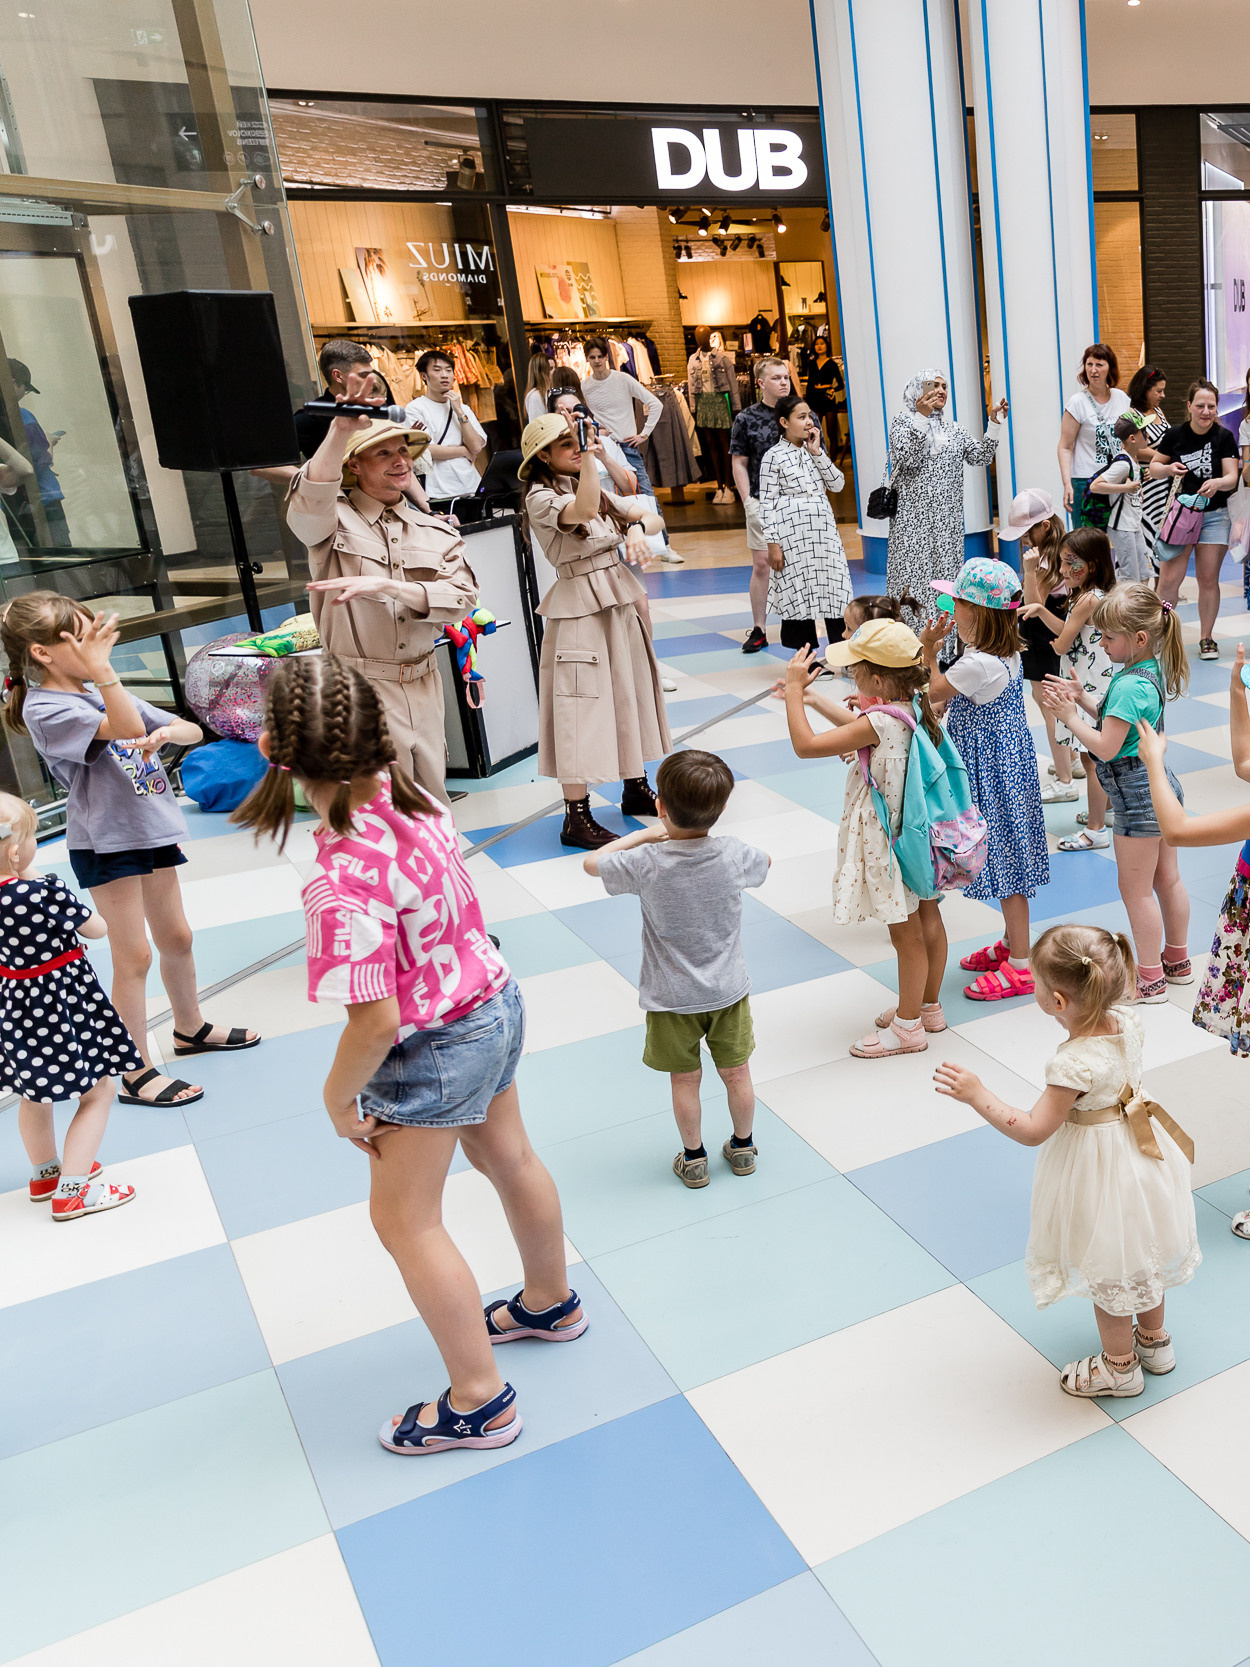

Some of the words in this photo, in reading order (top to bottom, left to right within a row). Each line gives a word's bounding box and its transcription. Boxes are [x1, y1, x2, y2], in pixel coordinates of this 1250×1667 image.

[651, 127, 808, 191] DUB
[331, 852, 380, 886] FILA
[333, 910, 351, 956] FILA
